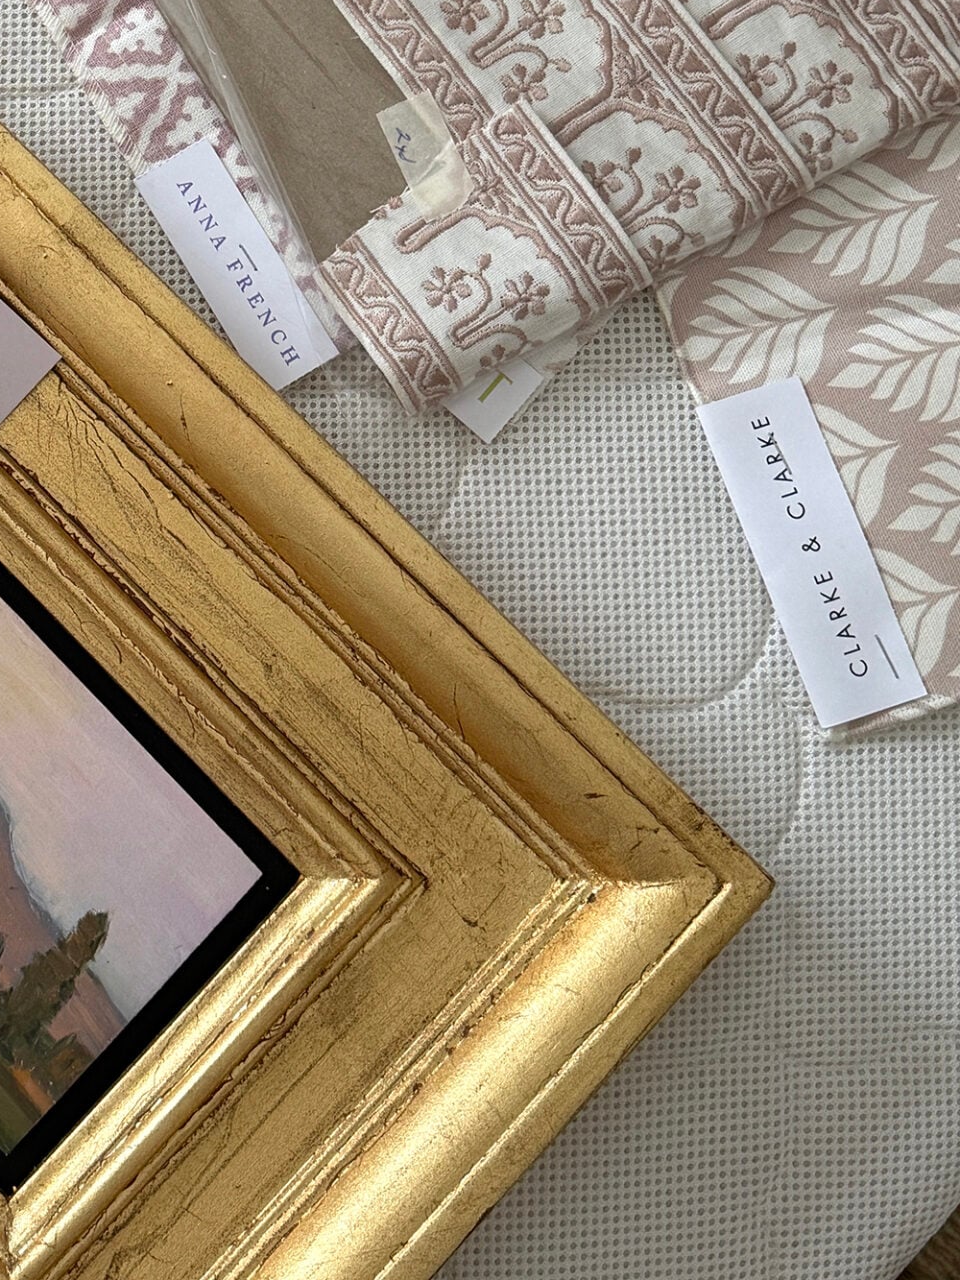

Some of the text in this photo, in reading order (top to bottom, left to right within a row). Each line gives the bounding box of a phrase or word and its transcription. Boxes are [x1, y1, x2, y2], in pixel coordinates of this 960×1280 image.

[176, 180, 301, 367] ANNA FRENCH
[751, 416, 868, 677] CLARKE & CLARKE
